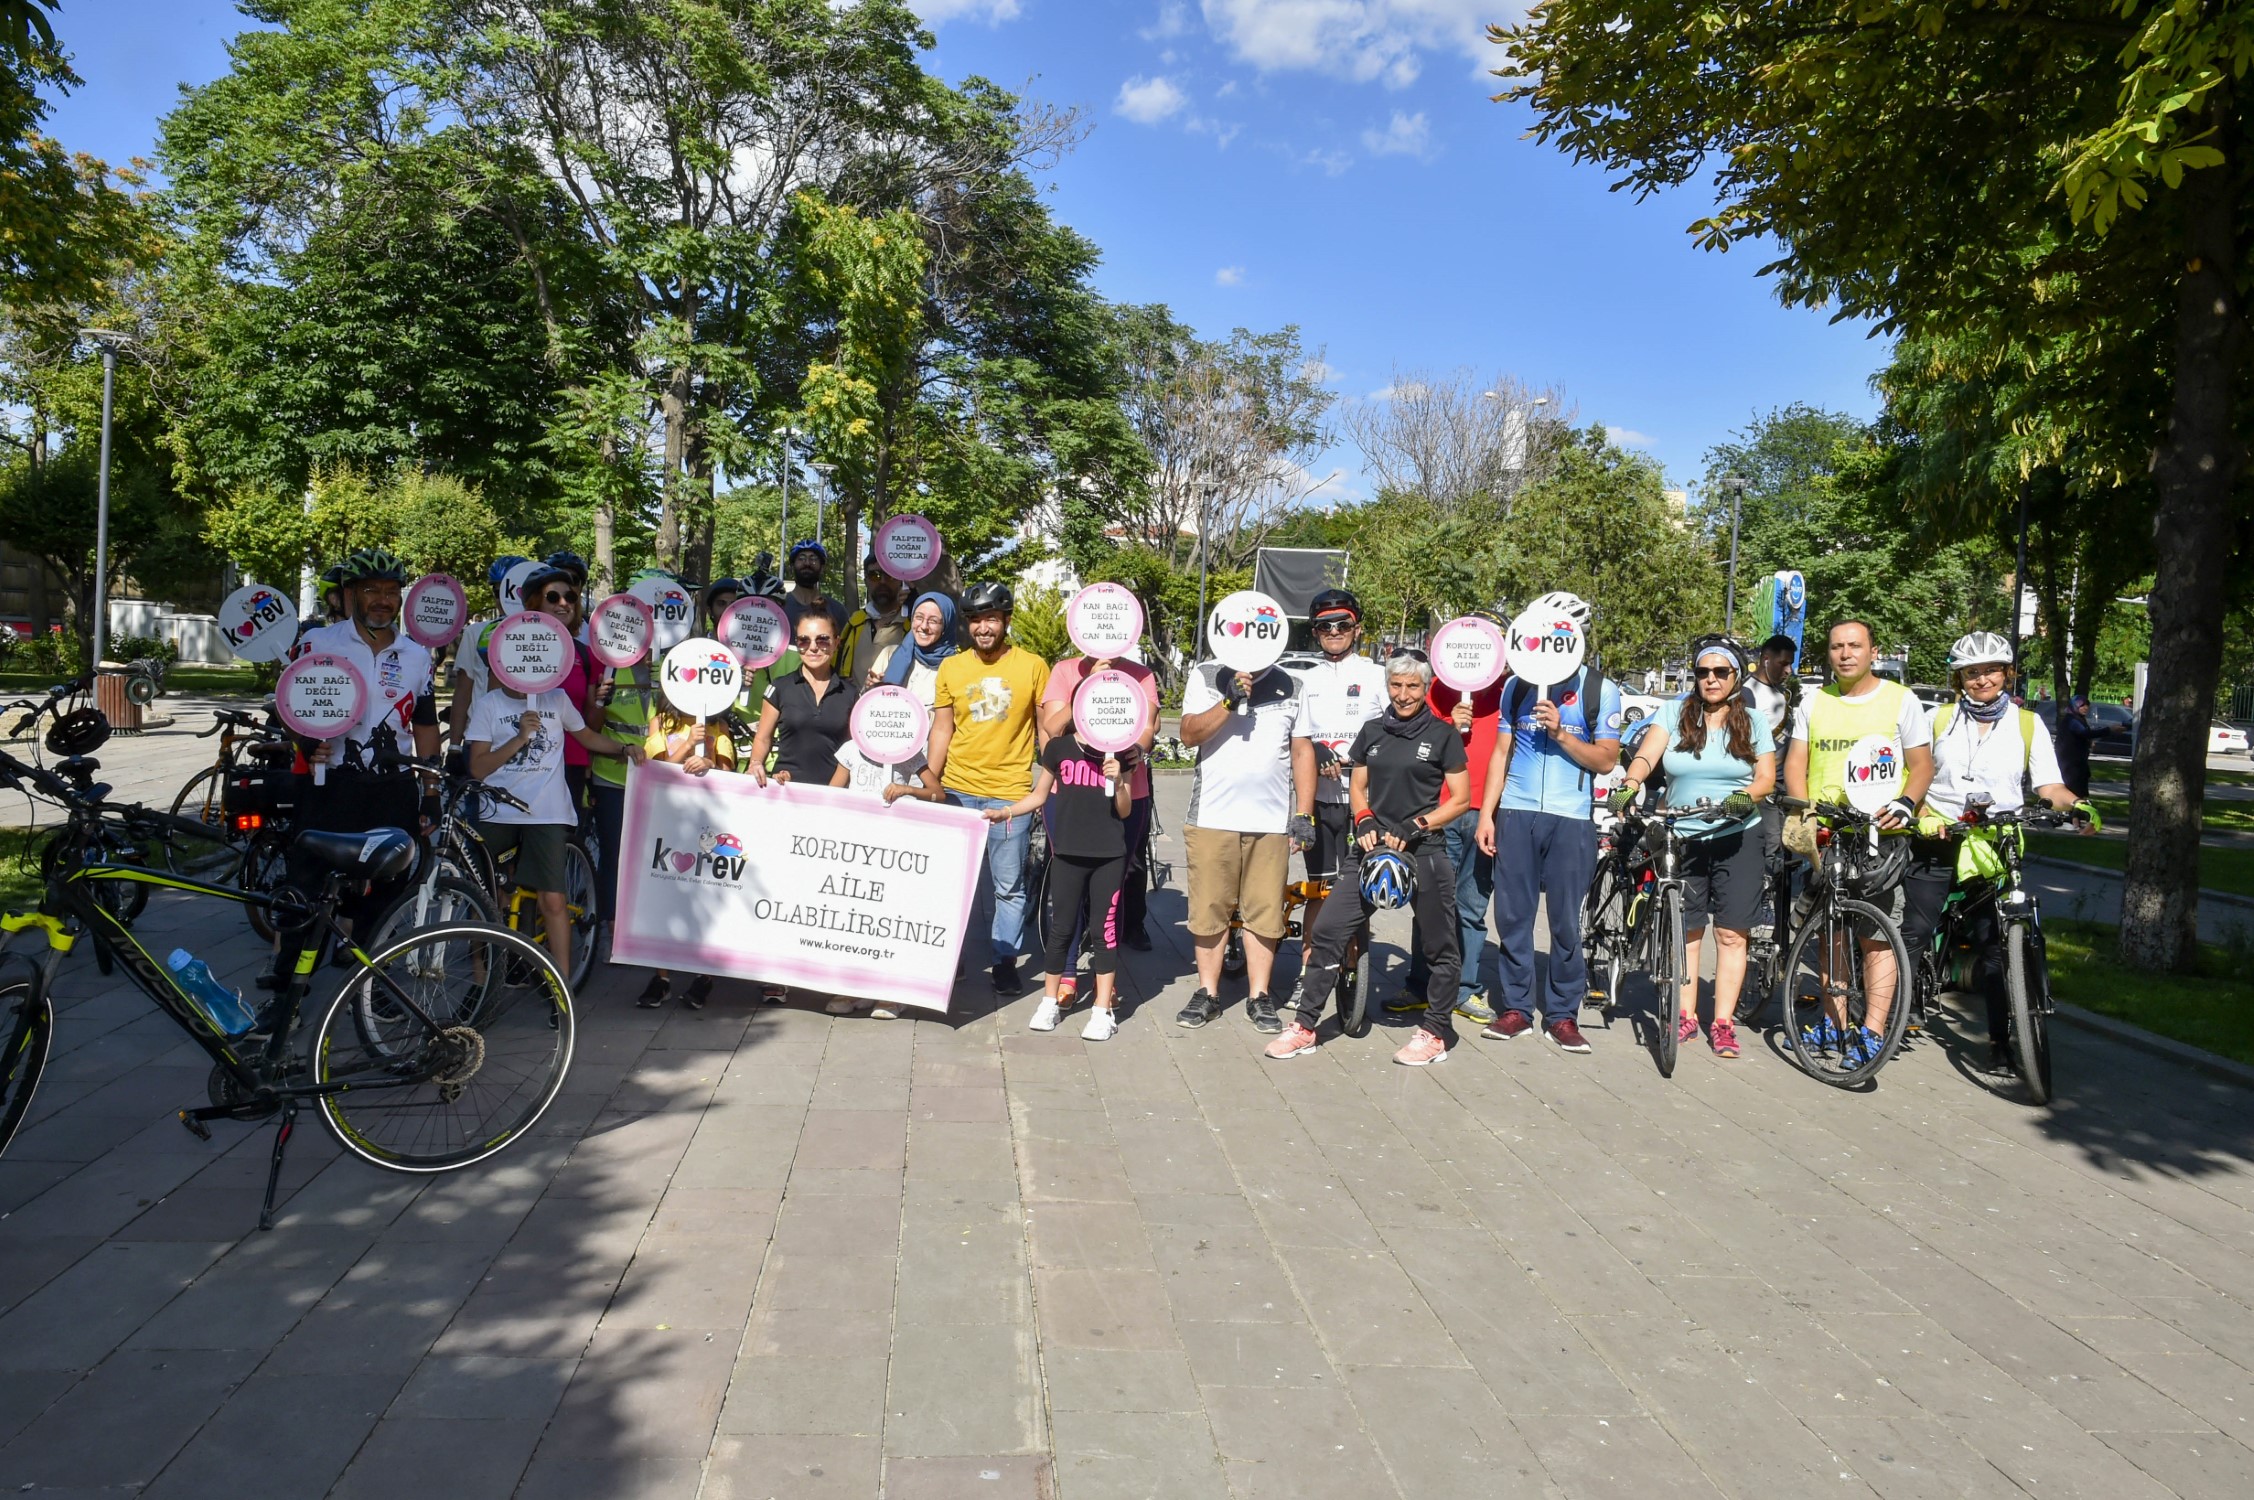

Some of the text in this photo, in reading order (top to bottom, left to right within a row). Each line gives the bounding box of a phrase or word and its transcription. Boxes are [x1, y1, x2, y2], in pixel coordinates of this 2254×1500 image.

[888, 552, 928, 560] ÇOCUKLAR
[420, 596, 455, 606] KALPTEN
[424, 606, 448, 615] DOĞAN
[416, 614, 454, 625] ÇOCUKLAR
[605, 610, 622, 620] KAN
[624, 614, 644, 626] BAĞI
[734, 613, 778, 626] KAN BAĞI
[610, 622, 636, 634] DEĞİL
[742, 623, 769, 634] DEĞİL
[532, 632, 558, 641] BAĞI
[612, 632, 628, 641] AMA
[745, 634, 762, 642] AMA
[516, 643, 548, 652] DEĞİL
[598, 638, 638, 654] CAN BAĞI
[730, 641, 774, 654] CAN BAĞI
[1446, 642, 1492, 650] KORUYUCU
[532, 664, 558, 673] BAĞI
[324, 675, 351, 684] BAĞI
[306, 686, 340, 695] DEĞİL
[294, 708, 350, 718] CAN BAĞI
[870, 710, 911, 718] KALPTEN
[1098, 706, 1126, 714] DOĞAN
[499, 714, 518, 724] TIGER
[1089, 718, 1134, 726] ÇOCUKLAR
[875, 720, 905, 728] DOĞAN
[790, 834, 930, 874] KORUYUCU
[818, 872, 885, 902] AİLE
[754, 898, 946, 948] OLABİLİRSİNİZ
[800, 938, 896, 960] www.korev.org.tr
